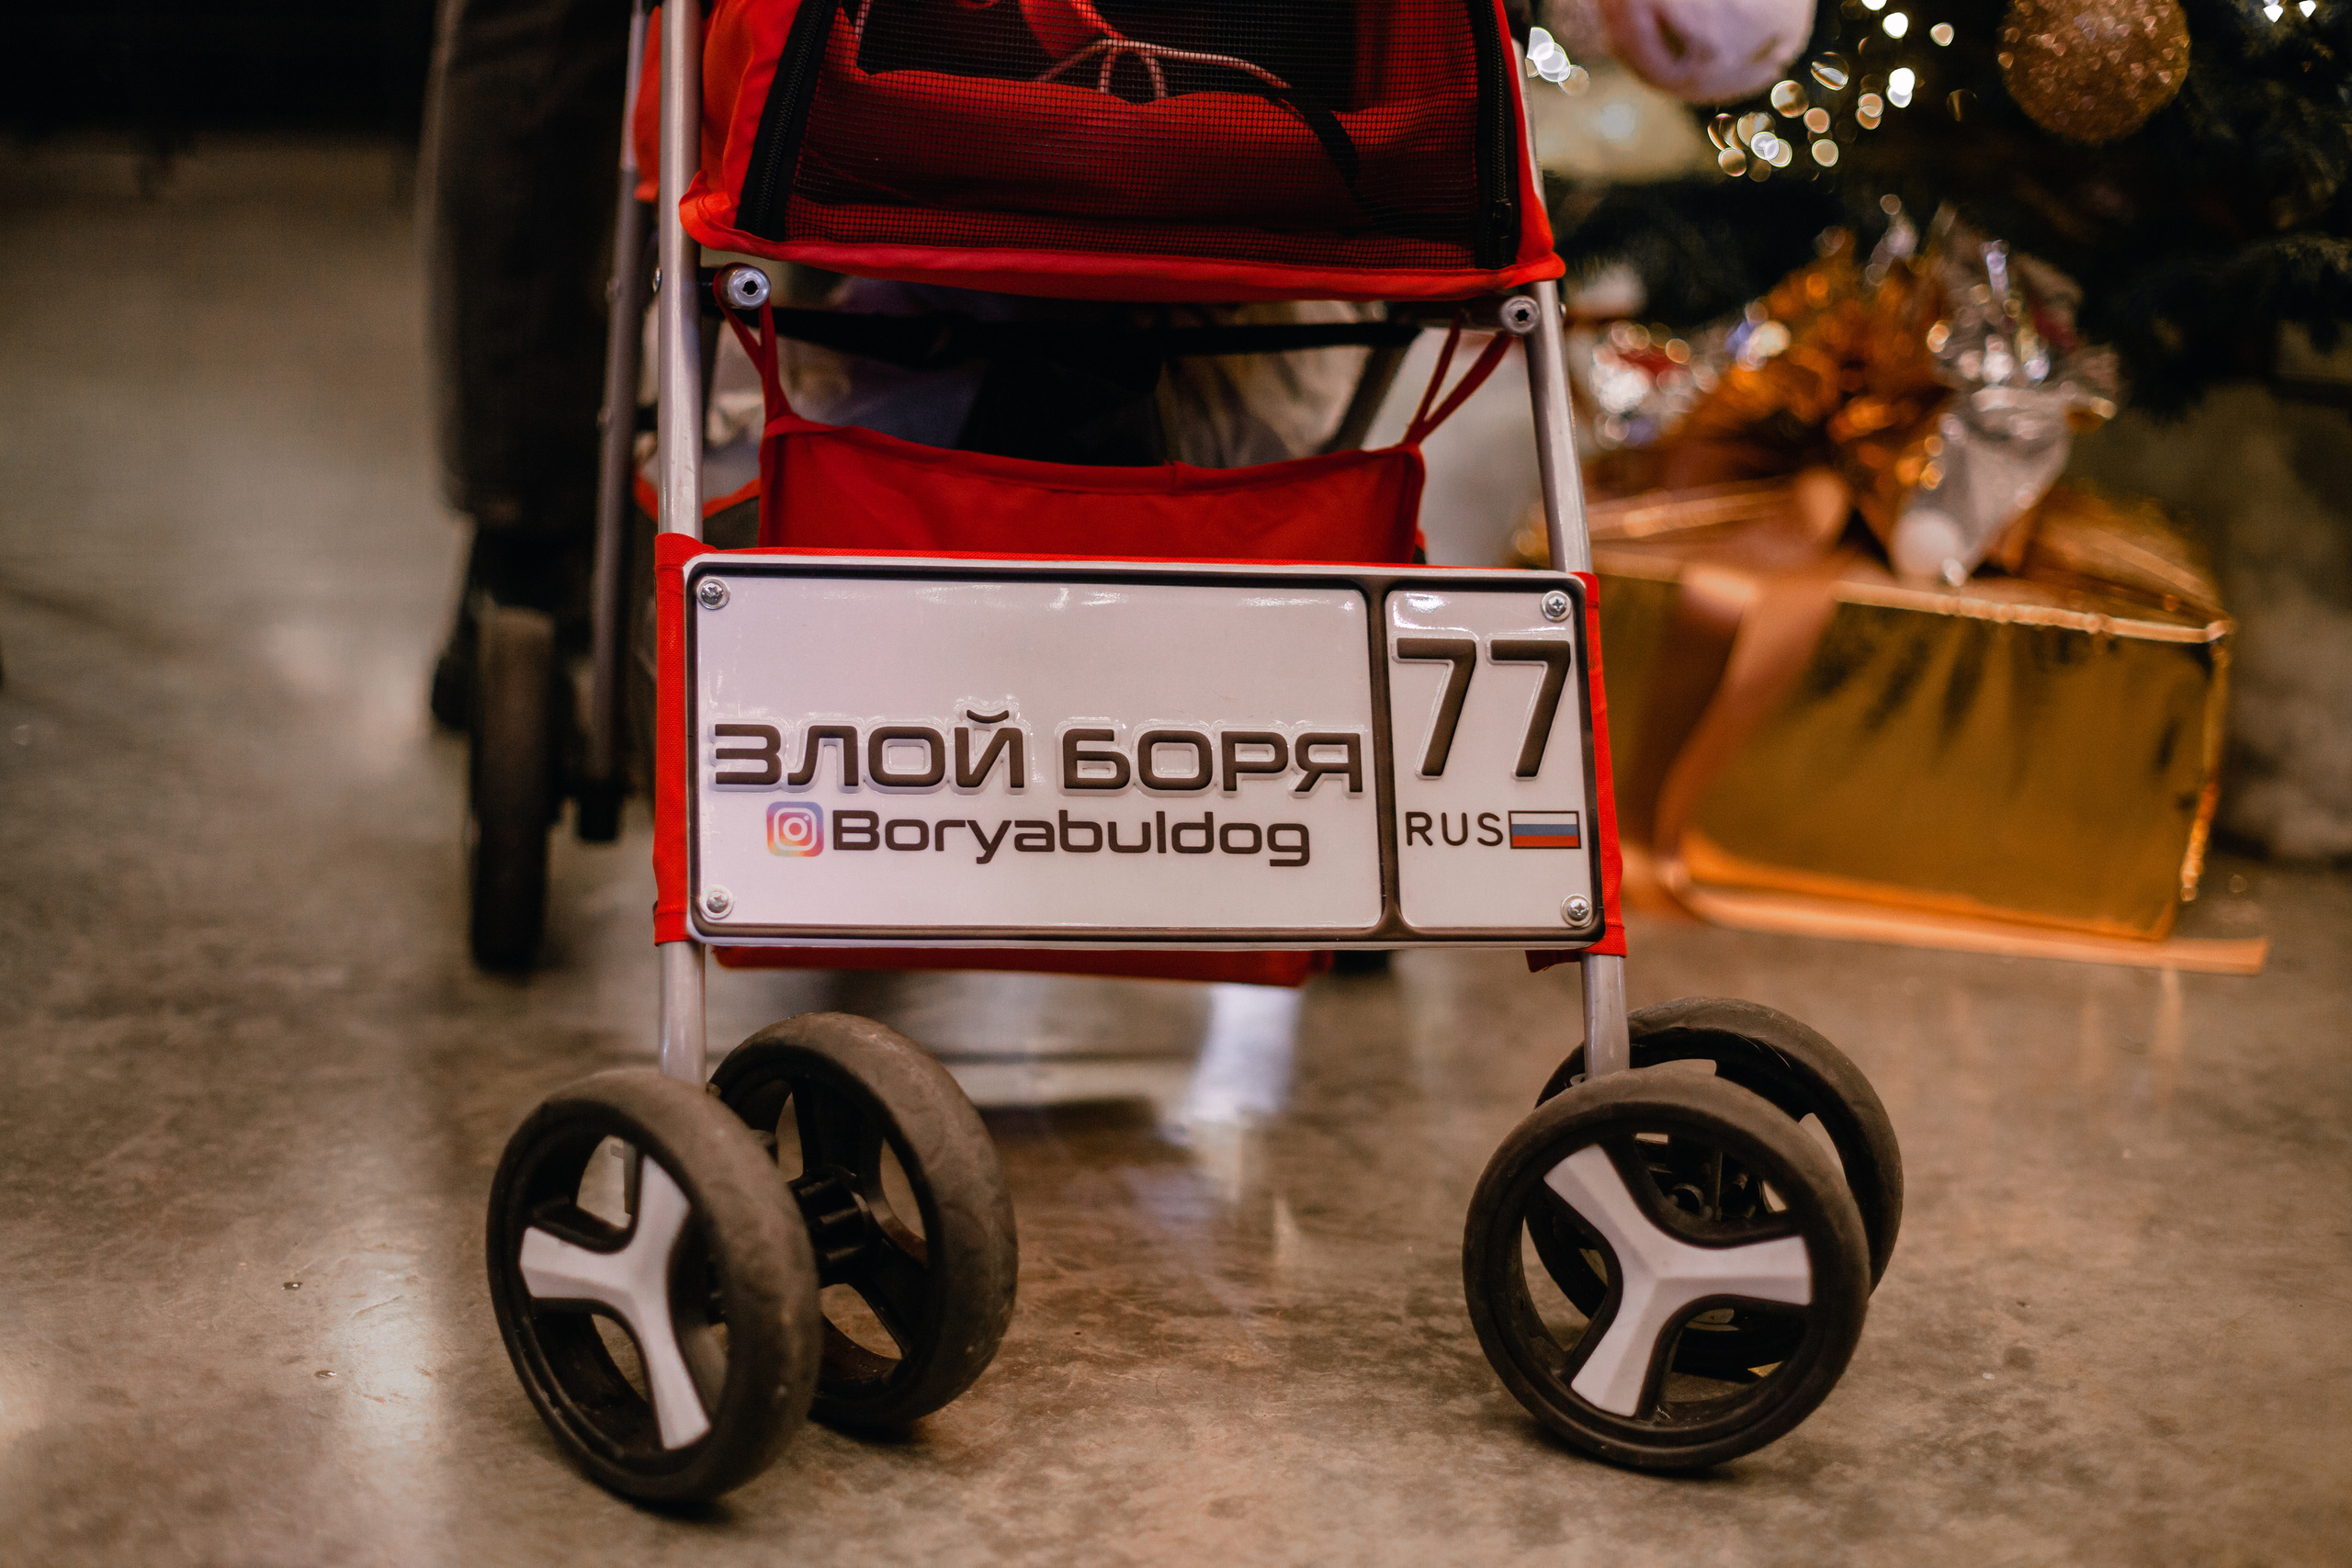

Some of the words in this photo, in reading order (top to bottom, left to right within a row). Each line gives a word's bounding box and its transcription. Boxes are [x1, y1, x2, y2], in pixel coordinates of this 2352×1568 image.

[1396, 637, 1572, 780] 77
[714, 708, 1026, 789] ЗЛОЙ
[1062, 728, 1363, 793] БОРЯ
[831, 809, 1310, 867] Boryabuldog
[1406, 811, 1505, 848] RUS
